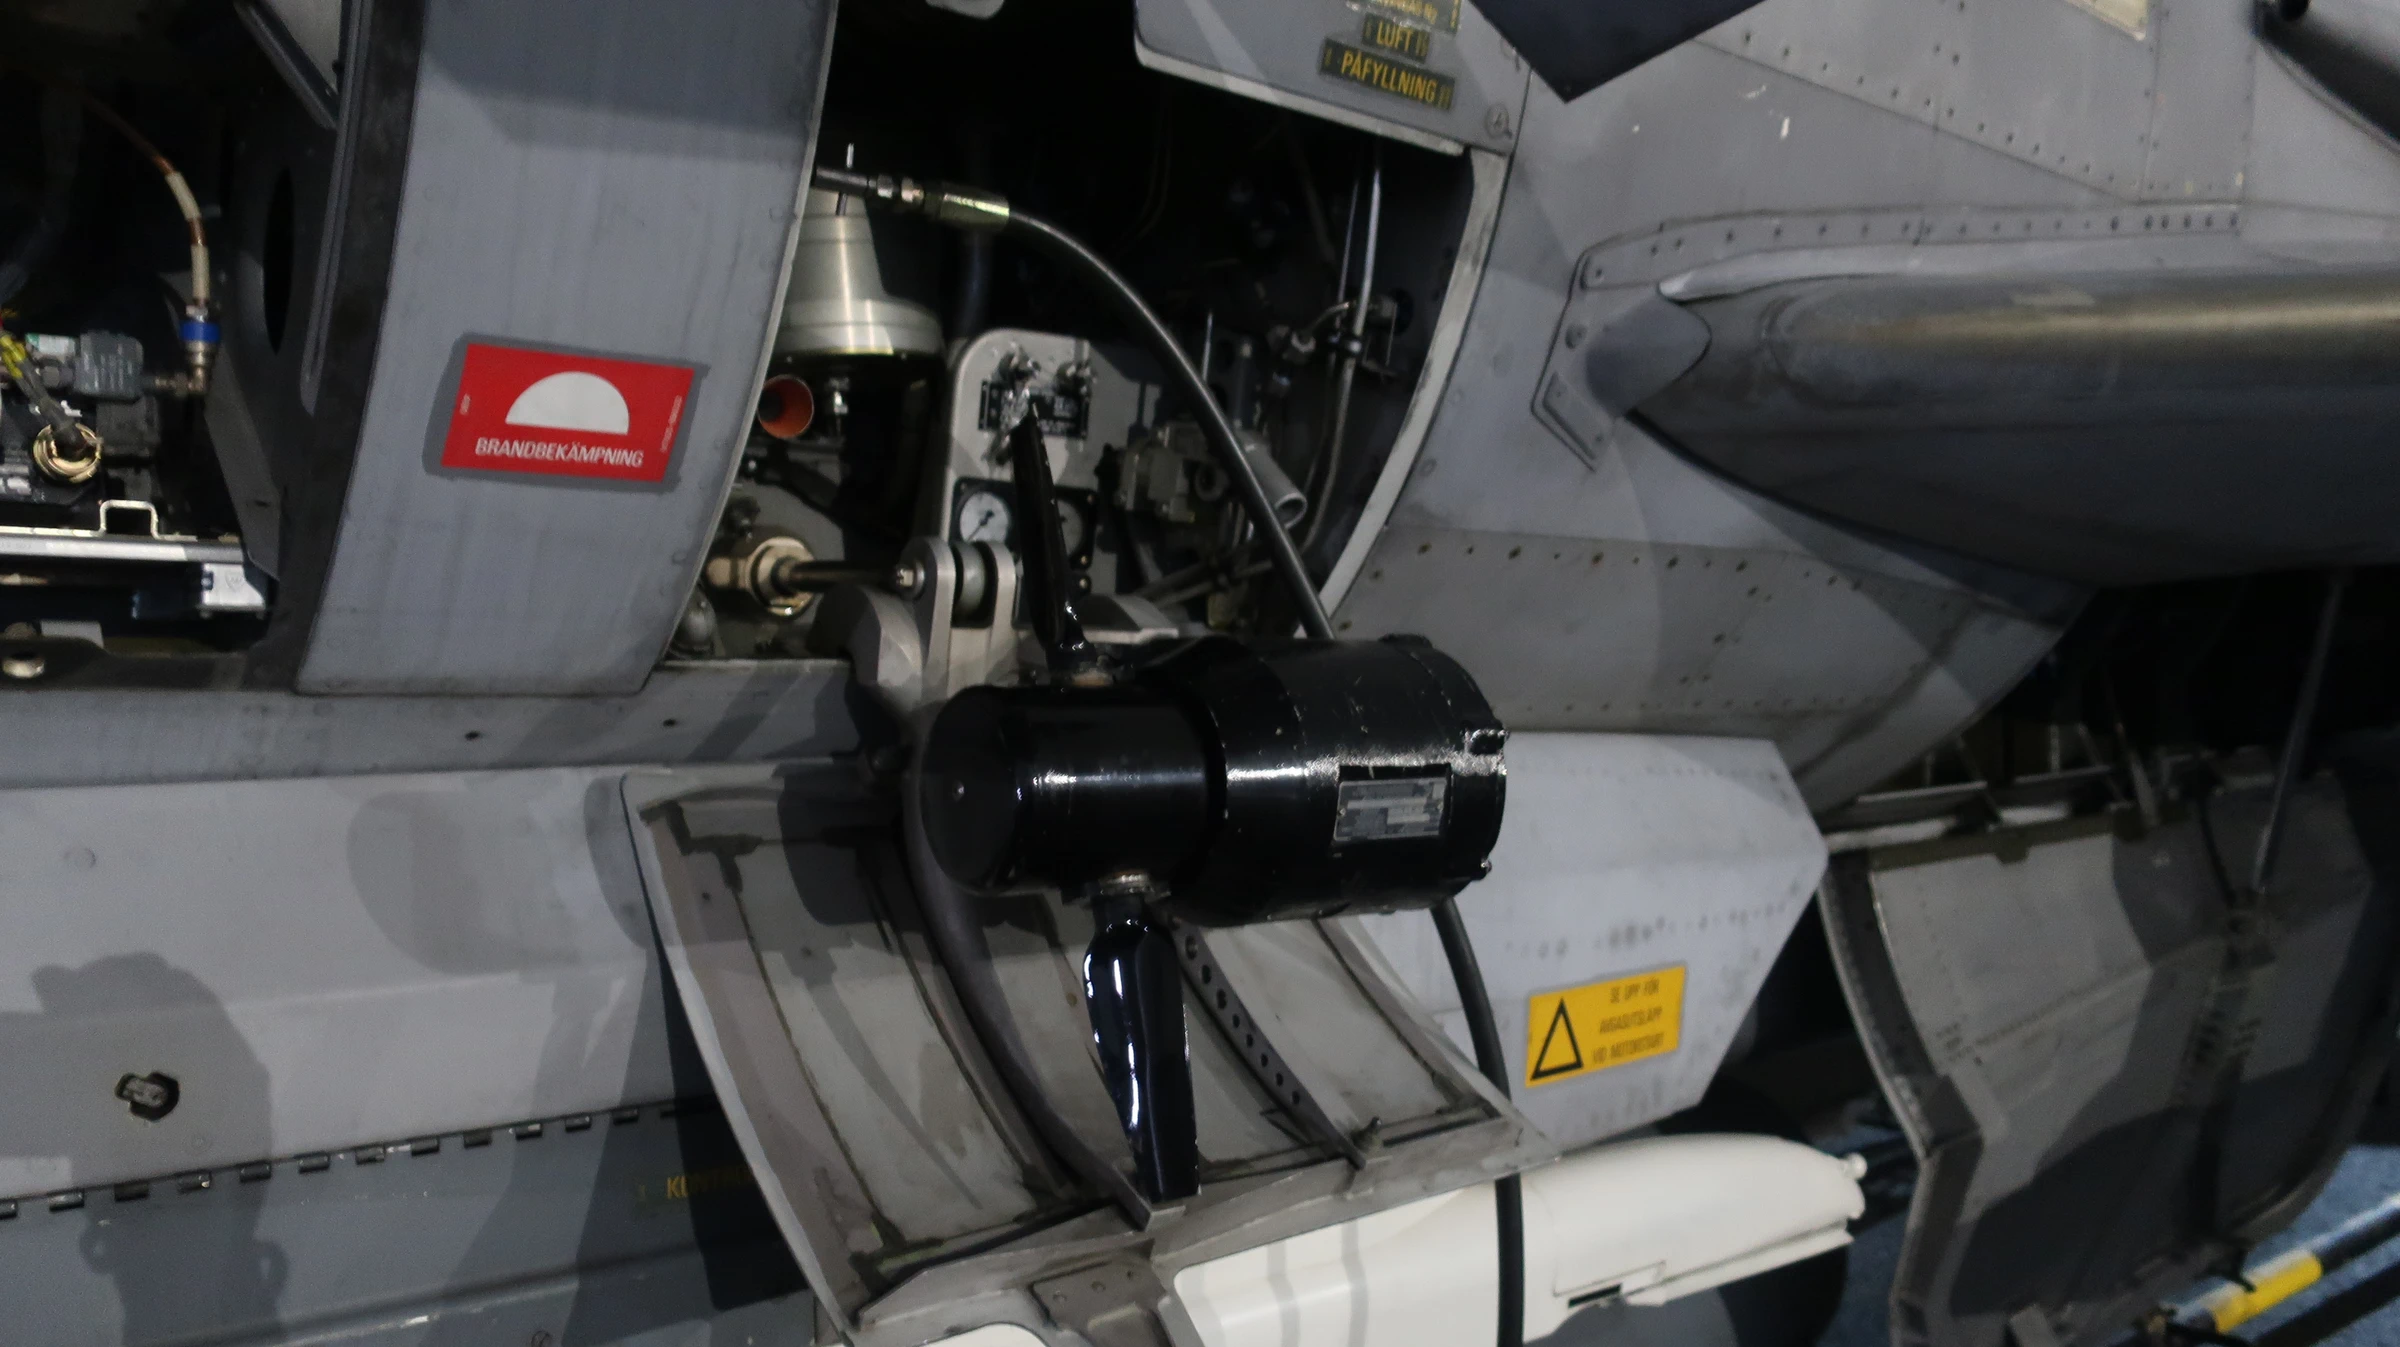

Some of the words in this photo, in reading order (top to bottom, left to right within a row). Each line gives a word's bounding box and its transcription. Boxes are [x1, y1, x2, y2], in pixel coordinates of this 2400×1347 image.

[1376, 20, 1415, 53] LUFT
[1341, 48, 1438, 103] PÅFYLLNING
[475, 437, 645, 468] BRANDBEKÄMPNING
